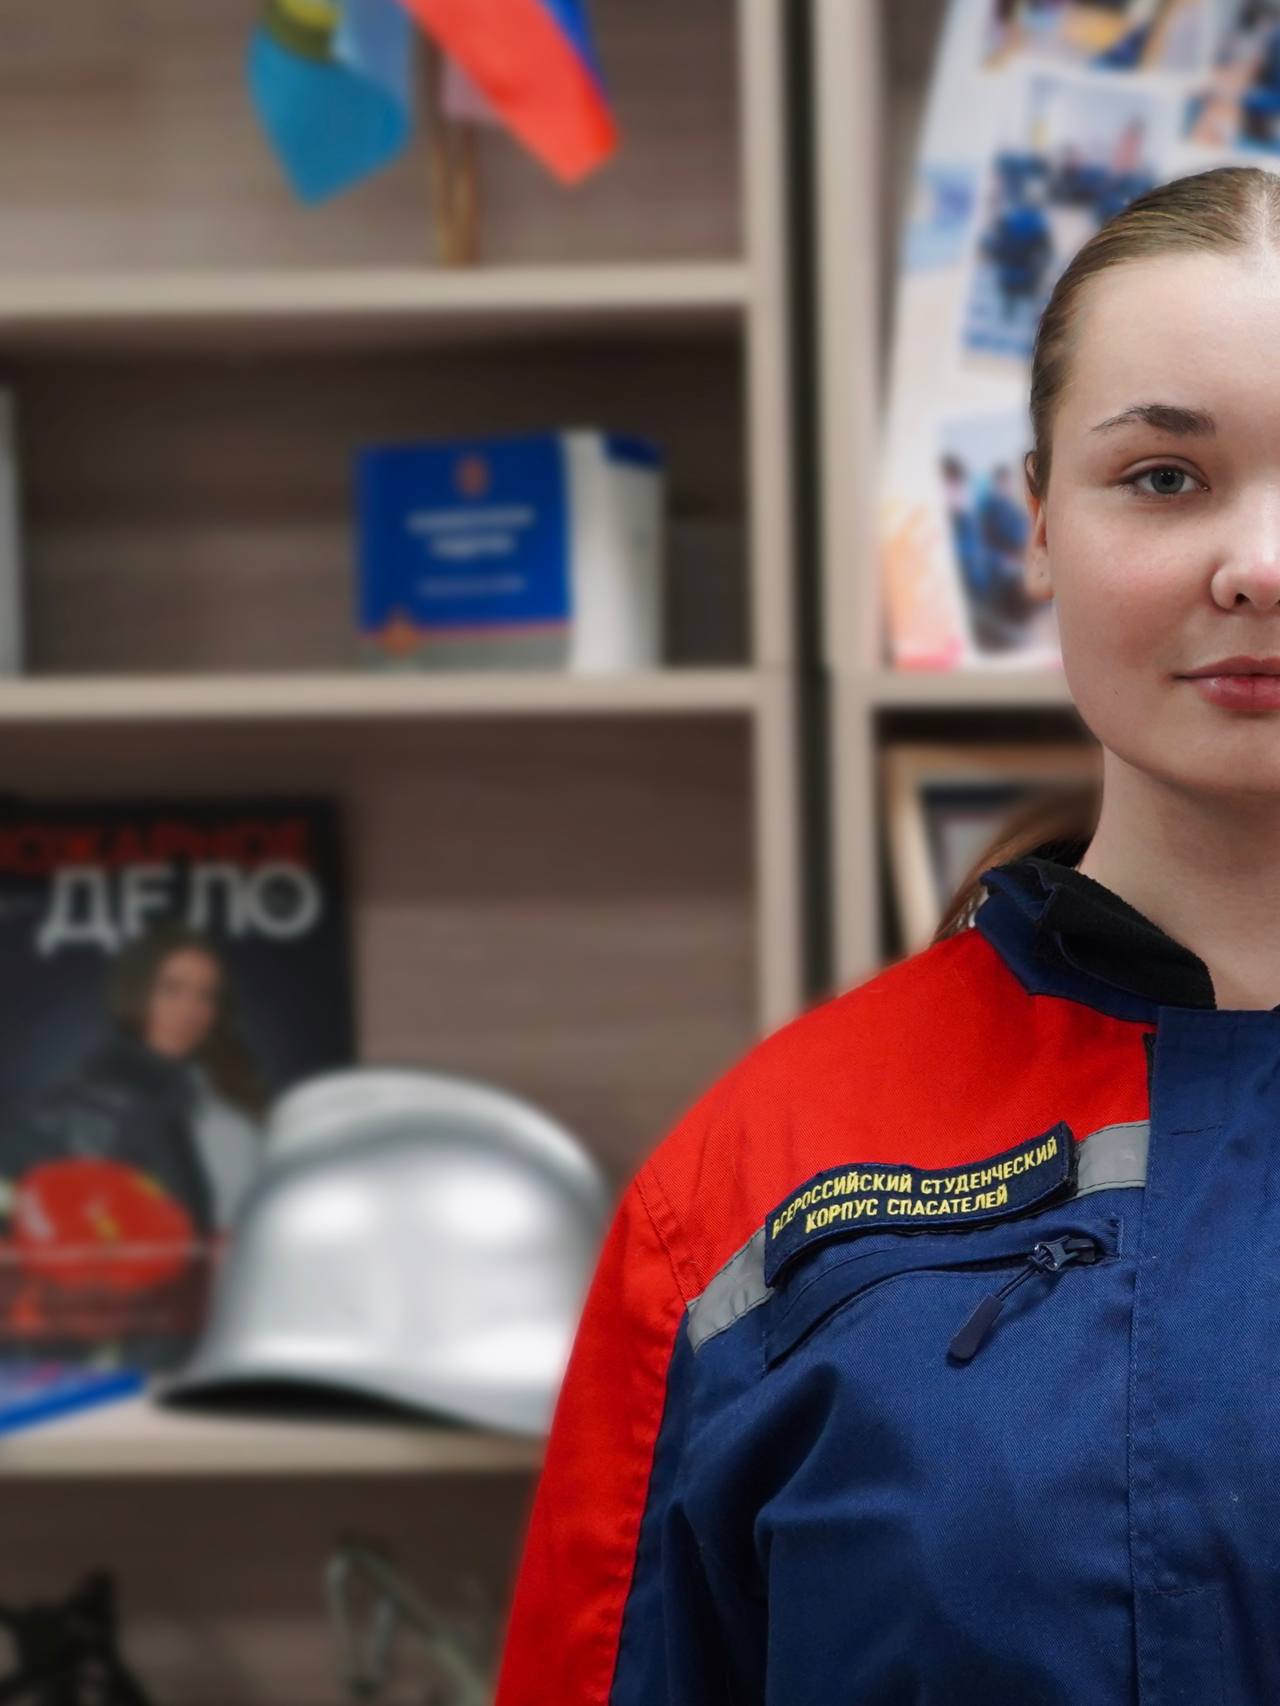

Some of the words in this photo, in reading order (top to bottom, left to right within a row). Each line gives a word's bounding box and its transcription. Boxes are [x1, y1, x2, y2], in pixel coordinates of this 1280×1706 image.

[37, 862, 321, 955] ДЕЛО
[771, 1171, 913, 1240] ВСЕРОССИЙСКИЙ
[920, 1136, 1058, 1196] СТУДЕНЧЕСКИЙ
[805, 1198, 879, 1234] КОРПУС
[887, 1184, 1009, 1216] СПАСАТЕЛЕЙ
